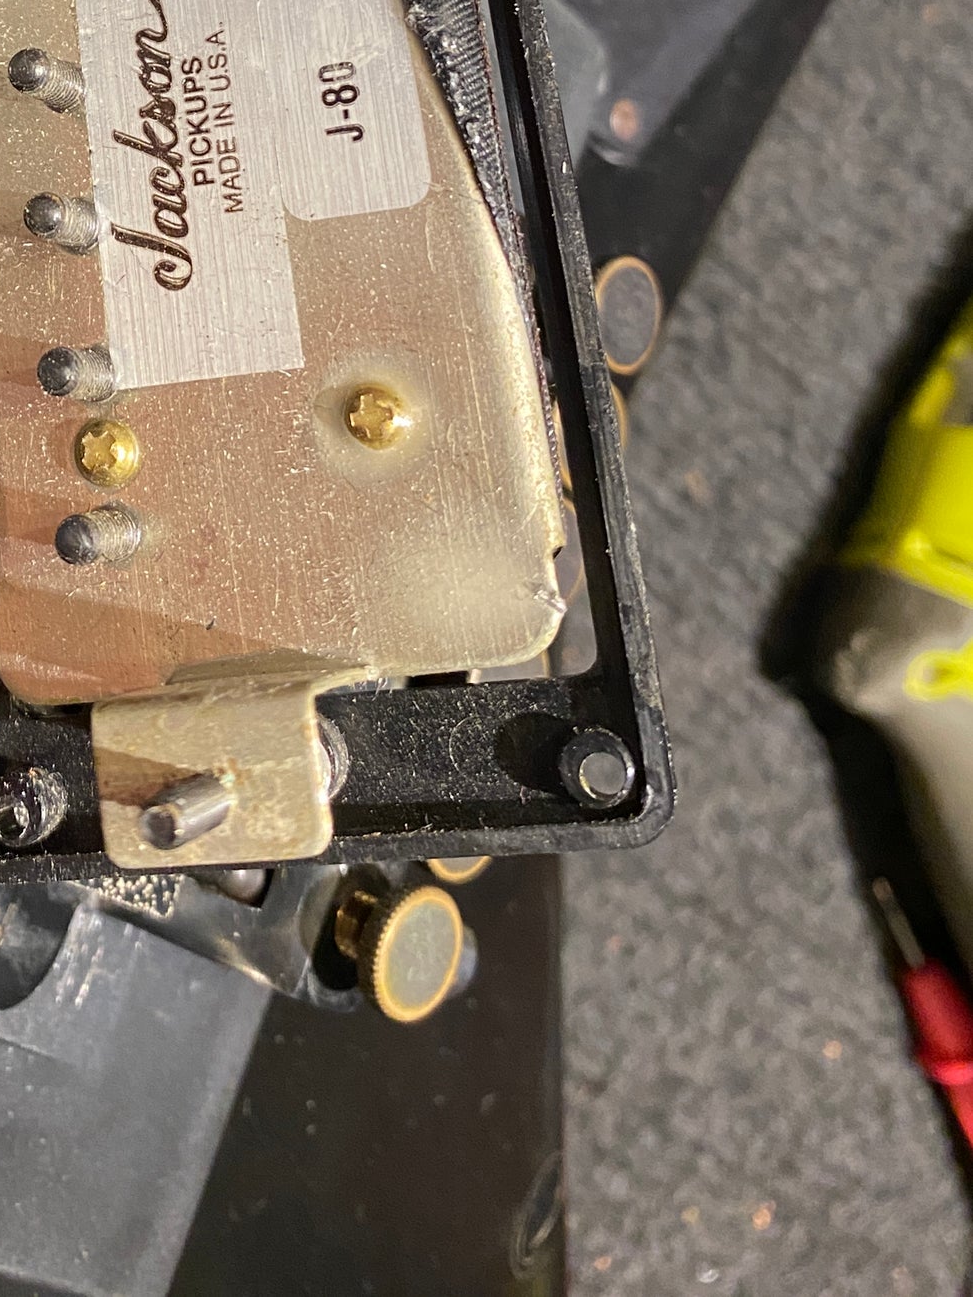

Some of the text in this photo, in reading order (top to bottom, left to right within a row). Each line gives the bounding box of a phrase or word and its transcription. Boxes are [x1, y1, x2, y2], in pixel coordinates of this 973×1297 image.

[181, 55, 216, 187] PICKUPS
[205, 20, 244, 214] MADE IN U.S.A.
[318, 61, 364, 143] J-80
